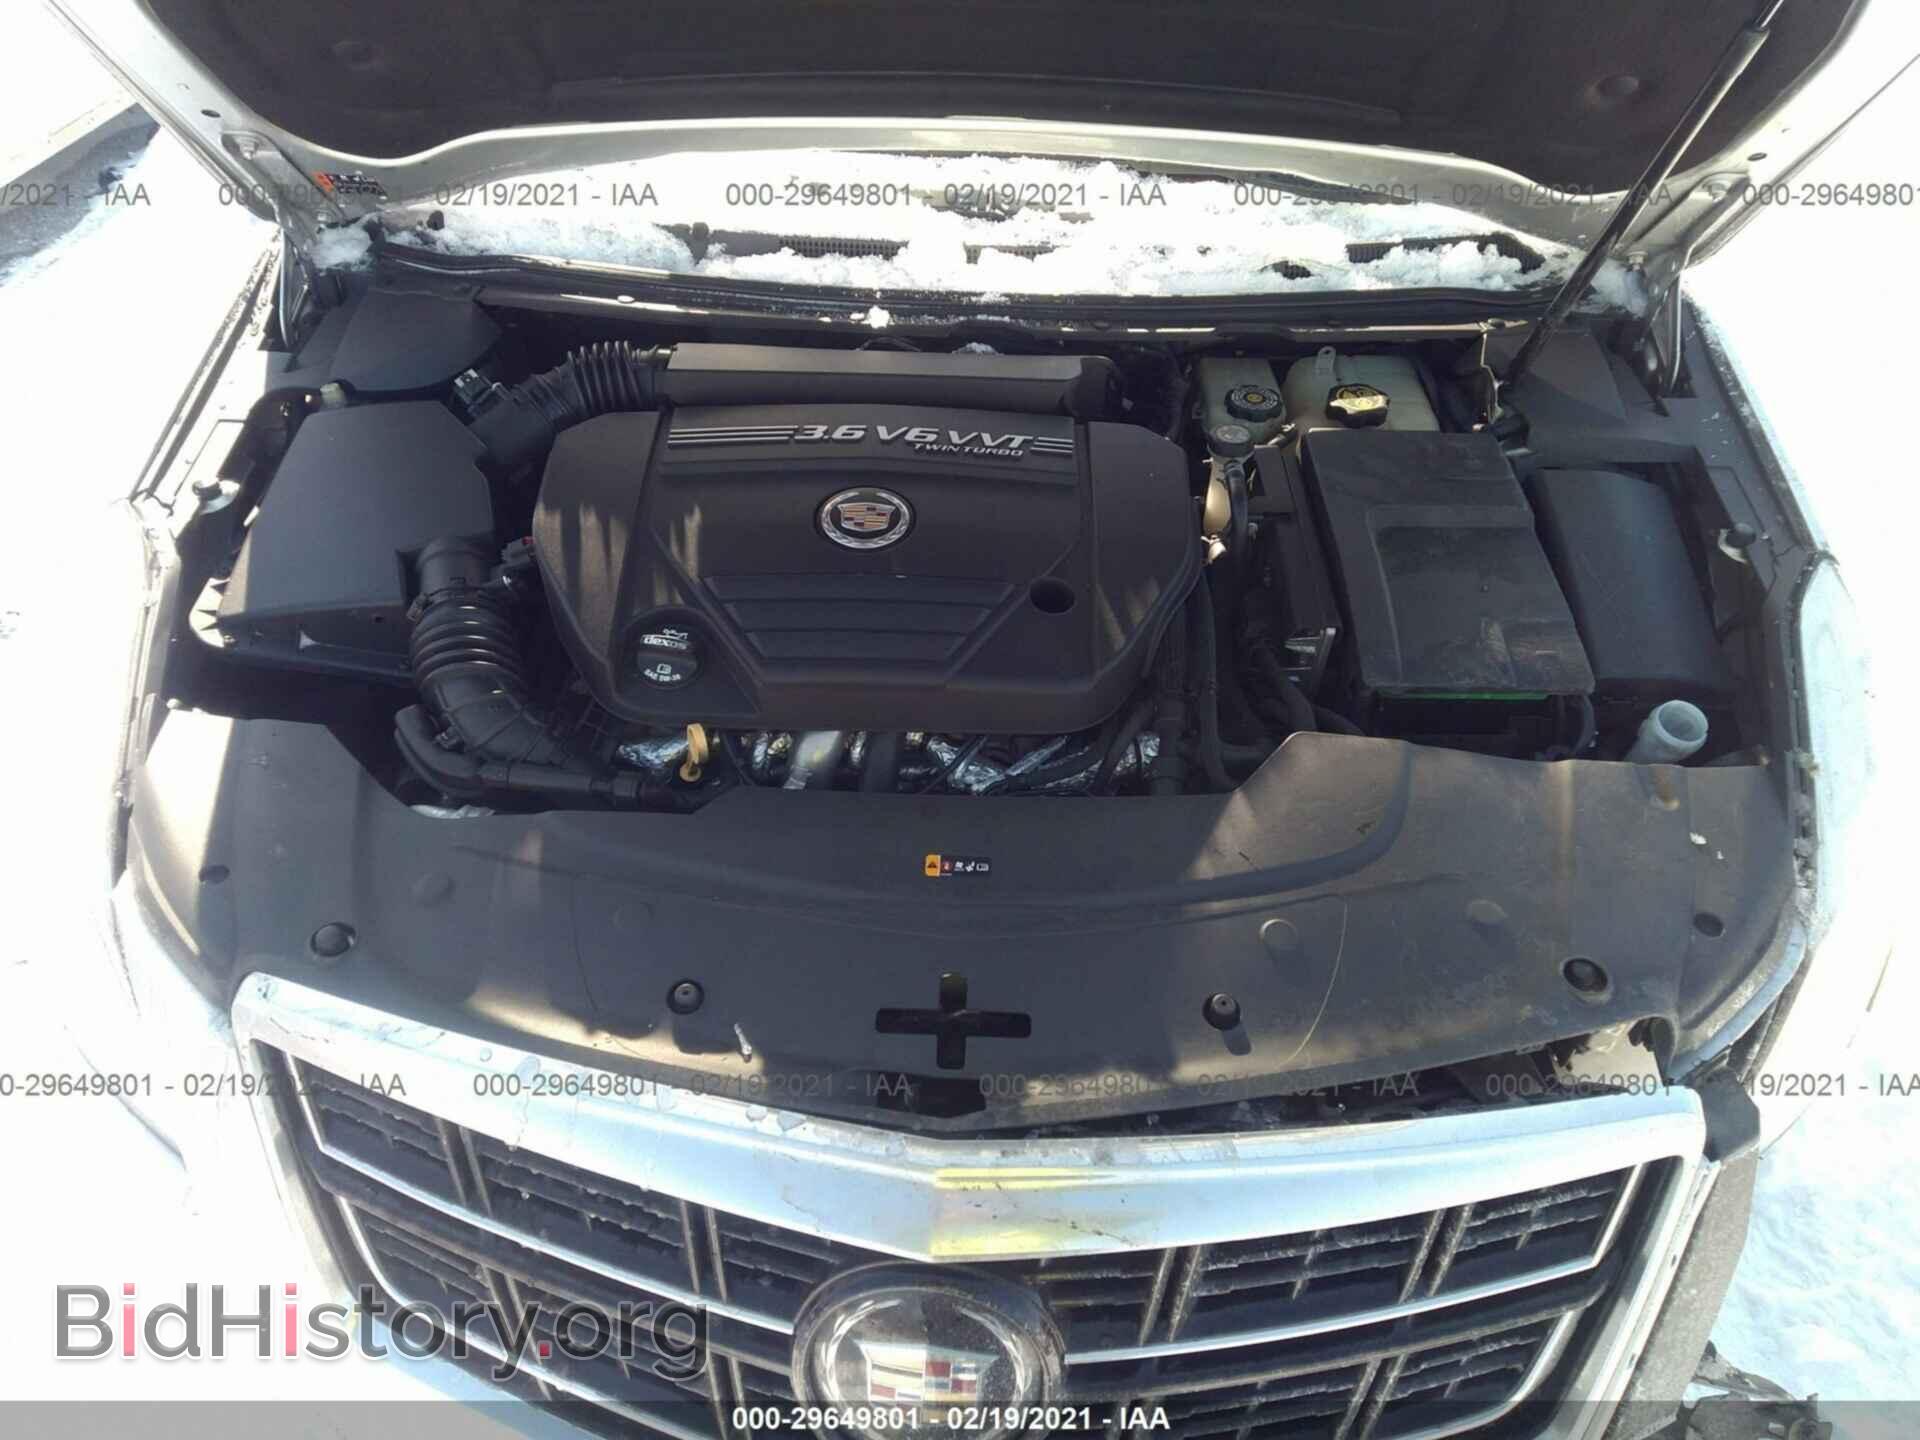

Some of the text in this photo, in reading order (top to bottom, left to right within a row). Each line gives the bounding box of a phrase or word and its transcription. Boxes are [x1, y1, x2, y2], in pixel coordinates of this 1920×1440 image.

[794, 424, 1033, 449] 3.6 V6 VVT
[913, 442, 1024, 457] TWIN TURBO
